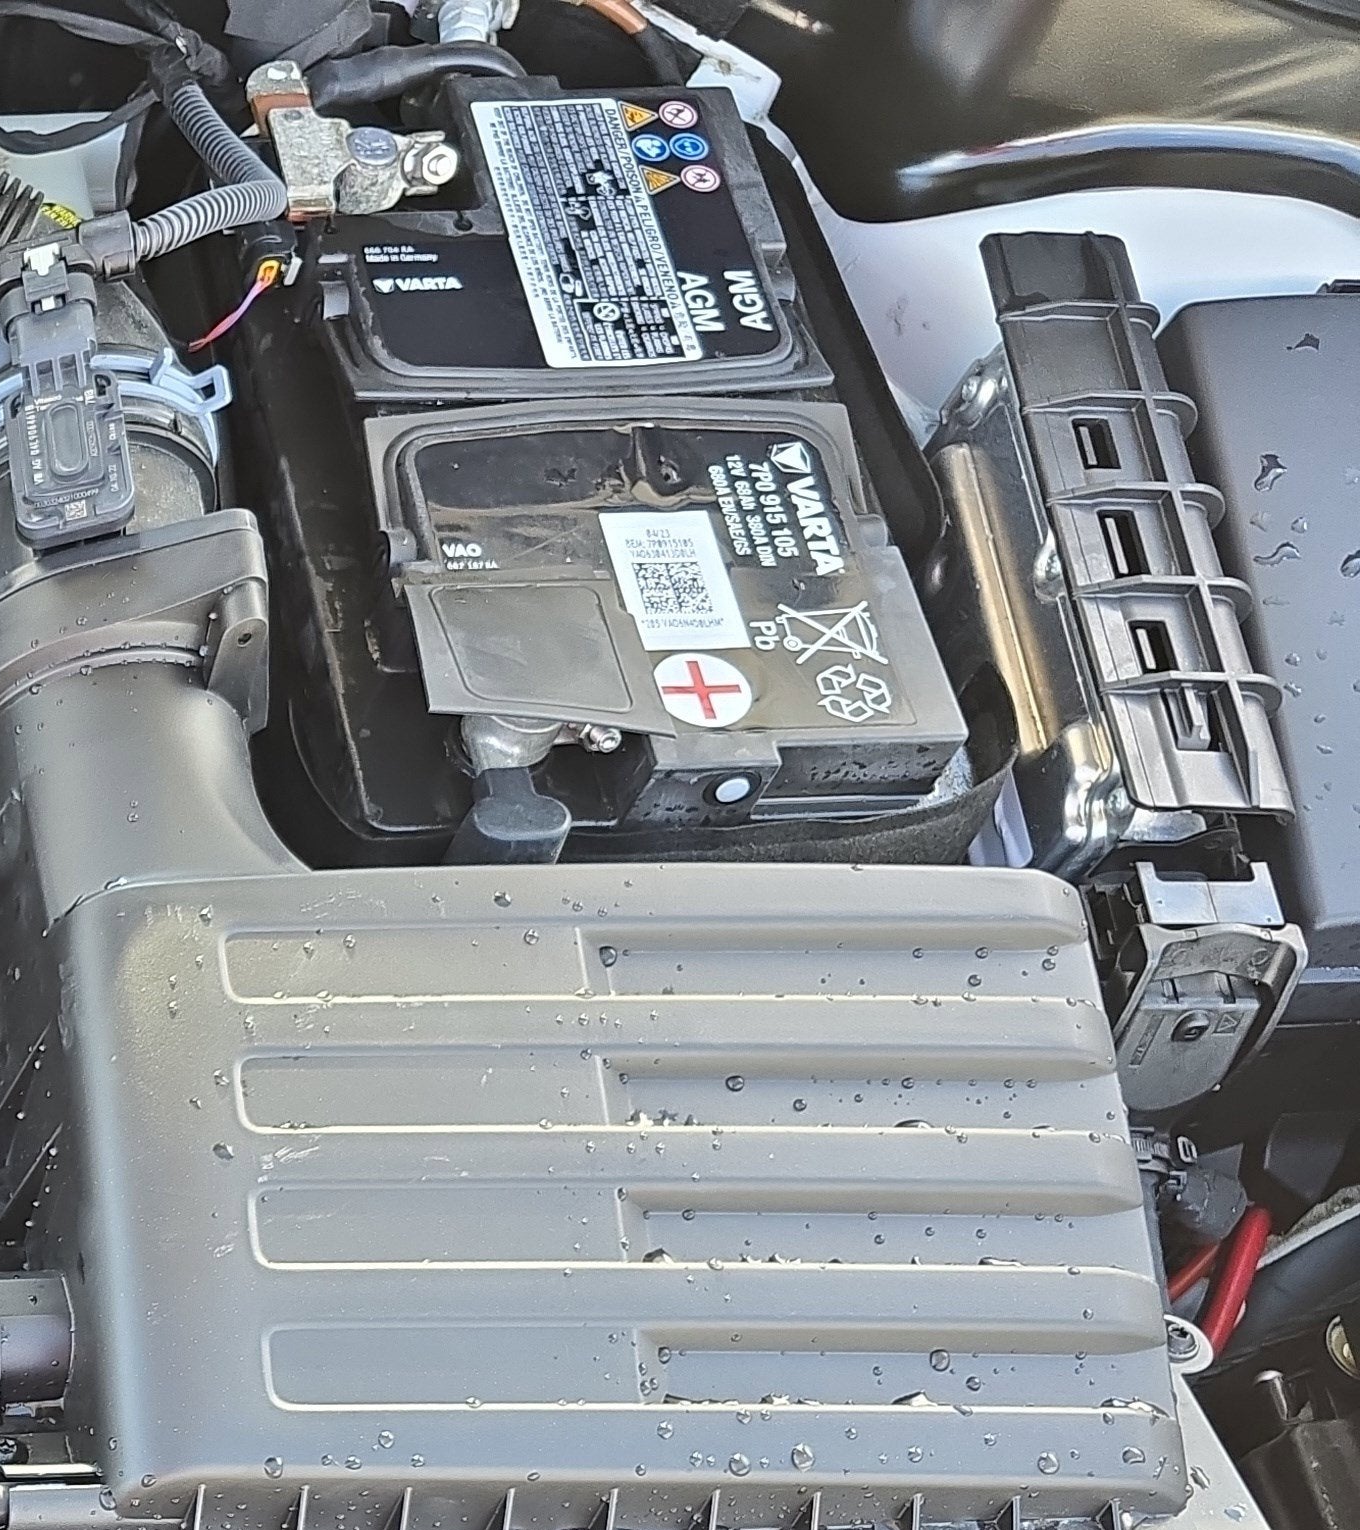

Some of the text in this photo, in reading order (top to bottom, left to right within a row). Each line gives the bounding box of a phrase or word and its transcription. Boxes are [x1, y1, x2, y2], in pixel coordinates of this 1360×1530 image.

[395, 276, 464, 291] VARTA
[677, 271, 726, 332] AGM
[724, 270, 773, 332] AGM
[708, 465, 730, 496] 680A
[725, 454, 777, 567] 12V 68Ah 380A DIN
[748, 461, 799, 558] 7P0 915 105
[787, 475, 845, 576] VARTA
[749, 620, 779, 650] Pb
